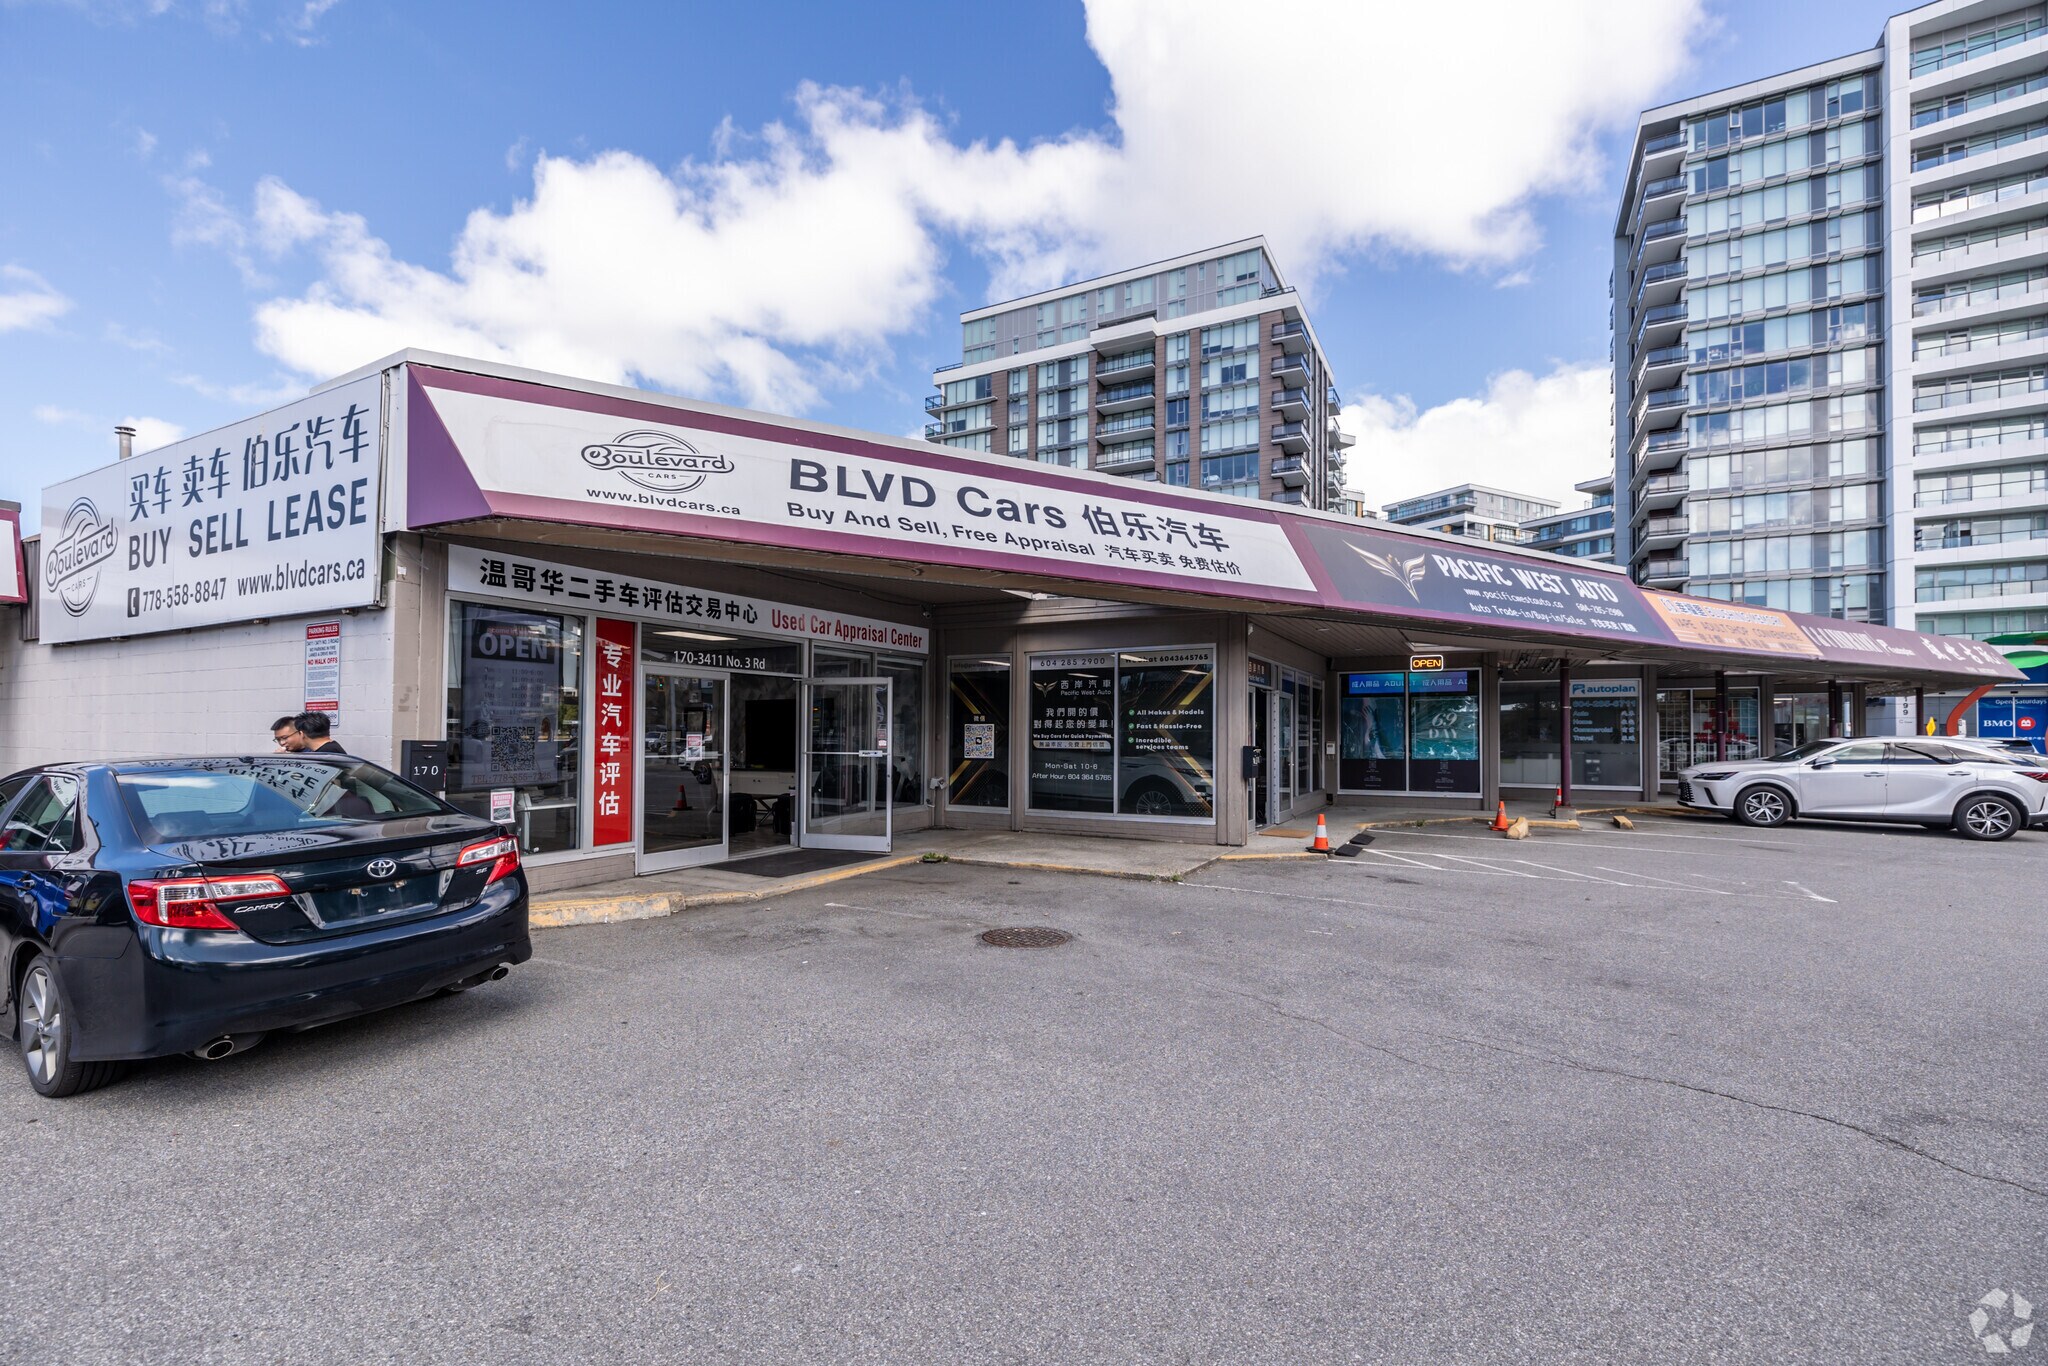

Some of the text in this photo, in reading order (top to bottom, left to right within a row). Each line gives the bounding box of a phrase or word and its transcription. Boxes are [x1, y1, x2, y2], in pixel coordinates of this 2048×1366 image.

[581, 444, 728, 470] Boulevard
[648, 472, 677, 480] CARS
[586, 488, 741, 515] www.blvdcars.ca
[789, 458, 1230, 553] BLVD Cars 伯乐汽车
[128, 477, 368, 571] BUY SELL LEASE
[786, 502, 835, 524] Buy
[844, 510, 891, 528] And
[897, 517, 948, 538] Sell,
[952, 525, 998, 543] Free
[1004, 532, 1095, 556] Appraisal
[46, 518, 117, 594] Boulevard
[71, 577, 88, 592] CARS
[142, 557, 366, 612] 778-558-8847 www.blvdcars.ca
[1431, 553, 1619, 603] PACIFIC WEST AUTO
[1469, 602, 1491, 614] Auto
[772, 608, 805, 632] Used
[811, 615, 831, 636] Car
[835, 619, 887, 643] Appraisal
[891, 628, 922, 649] Center
[478, 632, 548, 660] OPEN
[673, 651, 765, 669] 170-3411 No. 3 Rd
[1040, 658, 1057, 667] 604
[1061, 658, 1078, 666] 285
[1081, 657, 1106, 666] 2900
[1160, 654, 1208, 662] 6043645765
[1412, 659, 1441, 668] OPEN
[1587, 685, 1636, 693] autoplan
[1179, 708, 1204, 716] Models
[599, 643, 622, 816] 专业汽车评估
[1429, 728, 1457, 738] DAY
[413, 766, 439, 776] 170
[476, 867, 488, 875] SE
